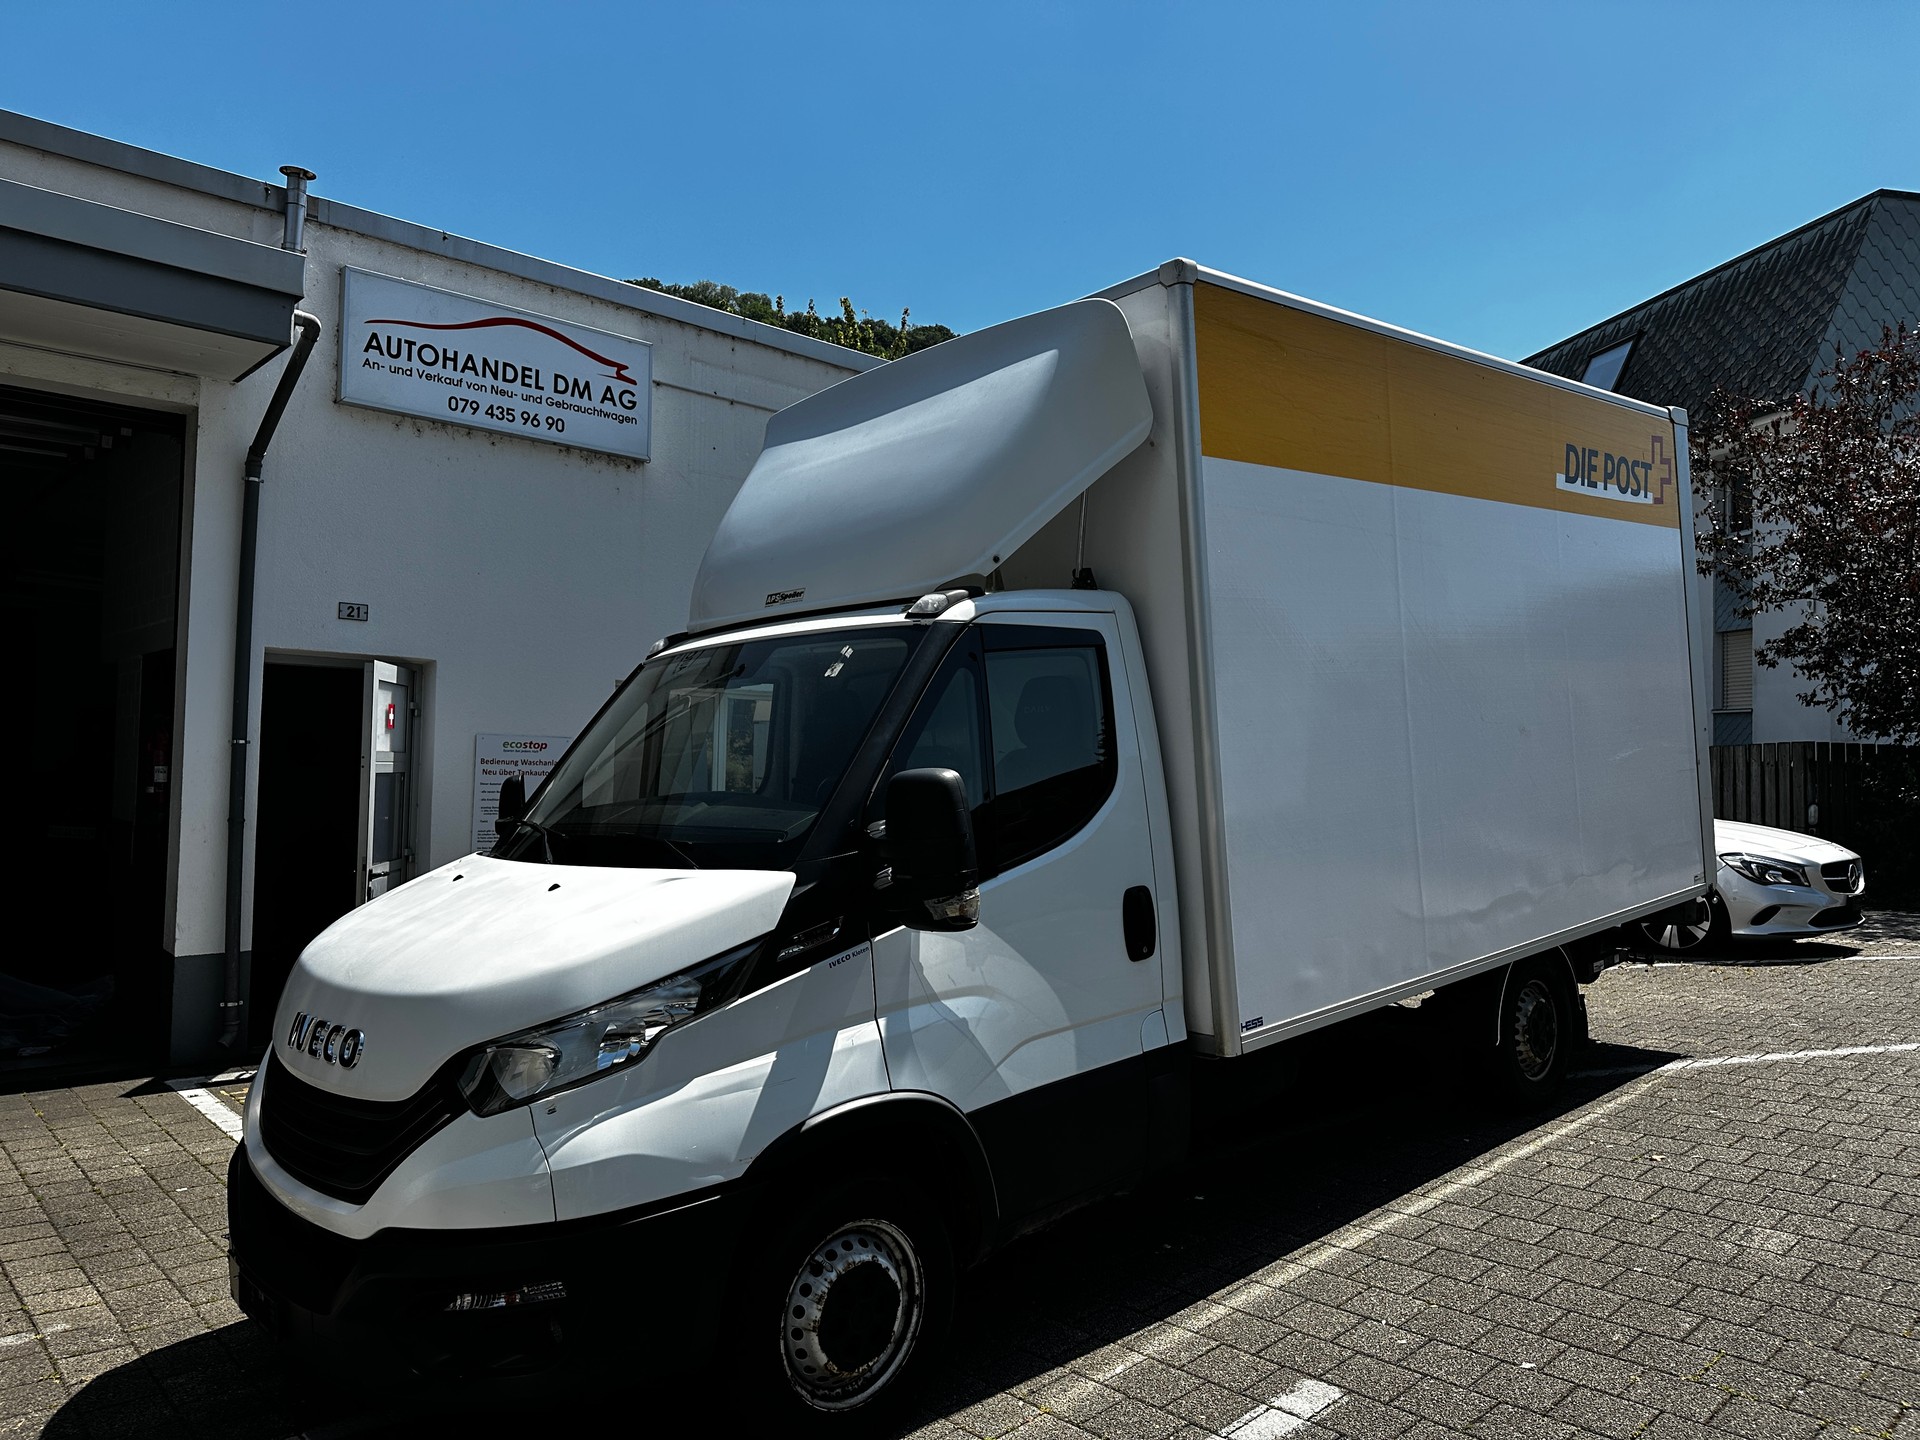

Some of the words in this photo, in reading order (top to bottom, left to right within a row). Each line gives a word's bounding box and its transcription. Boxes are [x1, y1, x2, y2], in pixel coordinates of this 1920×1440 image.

[363, 332, 545, 391] AUTOHANDEL
[553, 373, 592, 402] DM
[600, 385, 638, 411] AG
[362, 358, 385, 370] An-
[389, 364, 413, 377] und
[416, 368, 463, 388] Verkauf
[466, 381, 487, 393] von
[490, 385, 518, 399] Neu-
[521, 393, 542, 405] und
[545, 397, 638, 425] Gebrauchtwagen
[448, 396, 480, 415] 079
[485, 404, 516, 423] 435
[520, 411, 541, 428] 96
[545, 416, 565, 433] 90
[1565, 443, 1599, 489] DIE
[1603, 452, 1653, 499] POST
[346, 605, 361, 618] 21
[502, 740, 548, 751] ecostop
[480, 758, 519, 767] Bedienung
[482, 768, 498, 776] Neu
[499, 768, 516, 776] über
[829, 954, 851, 968] IVECO
[1241, 1016, 1263, 1032] HESS
[287, 1011, 366, 1070] IVECO
